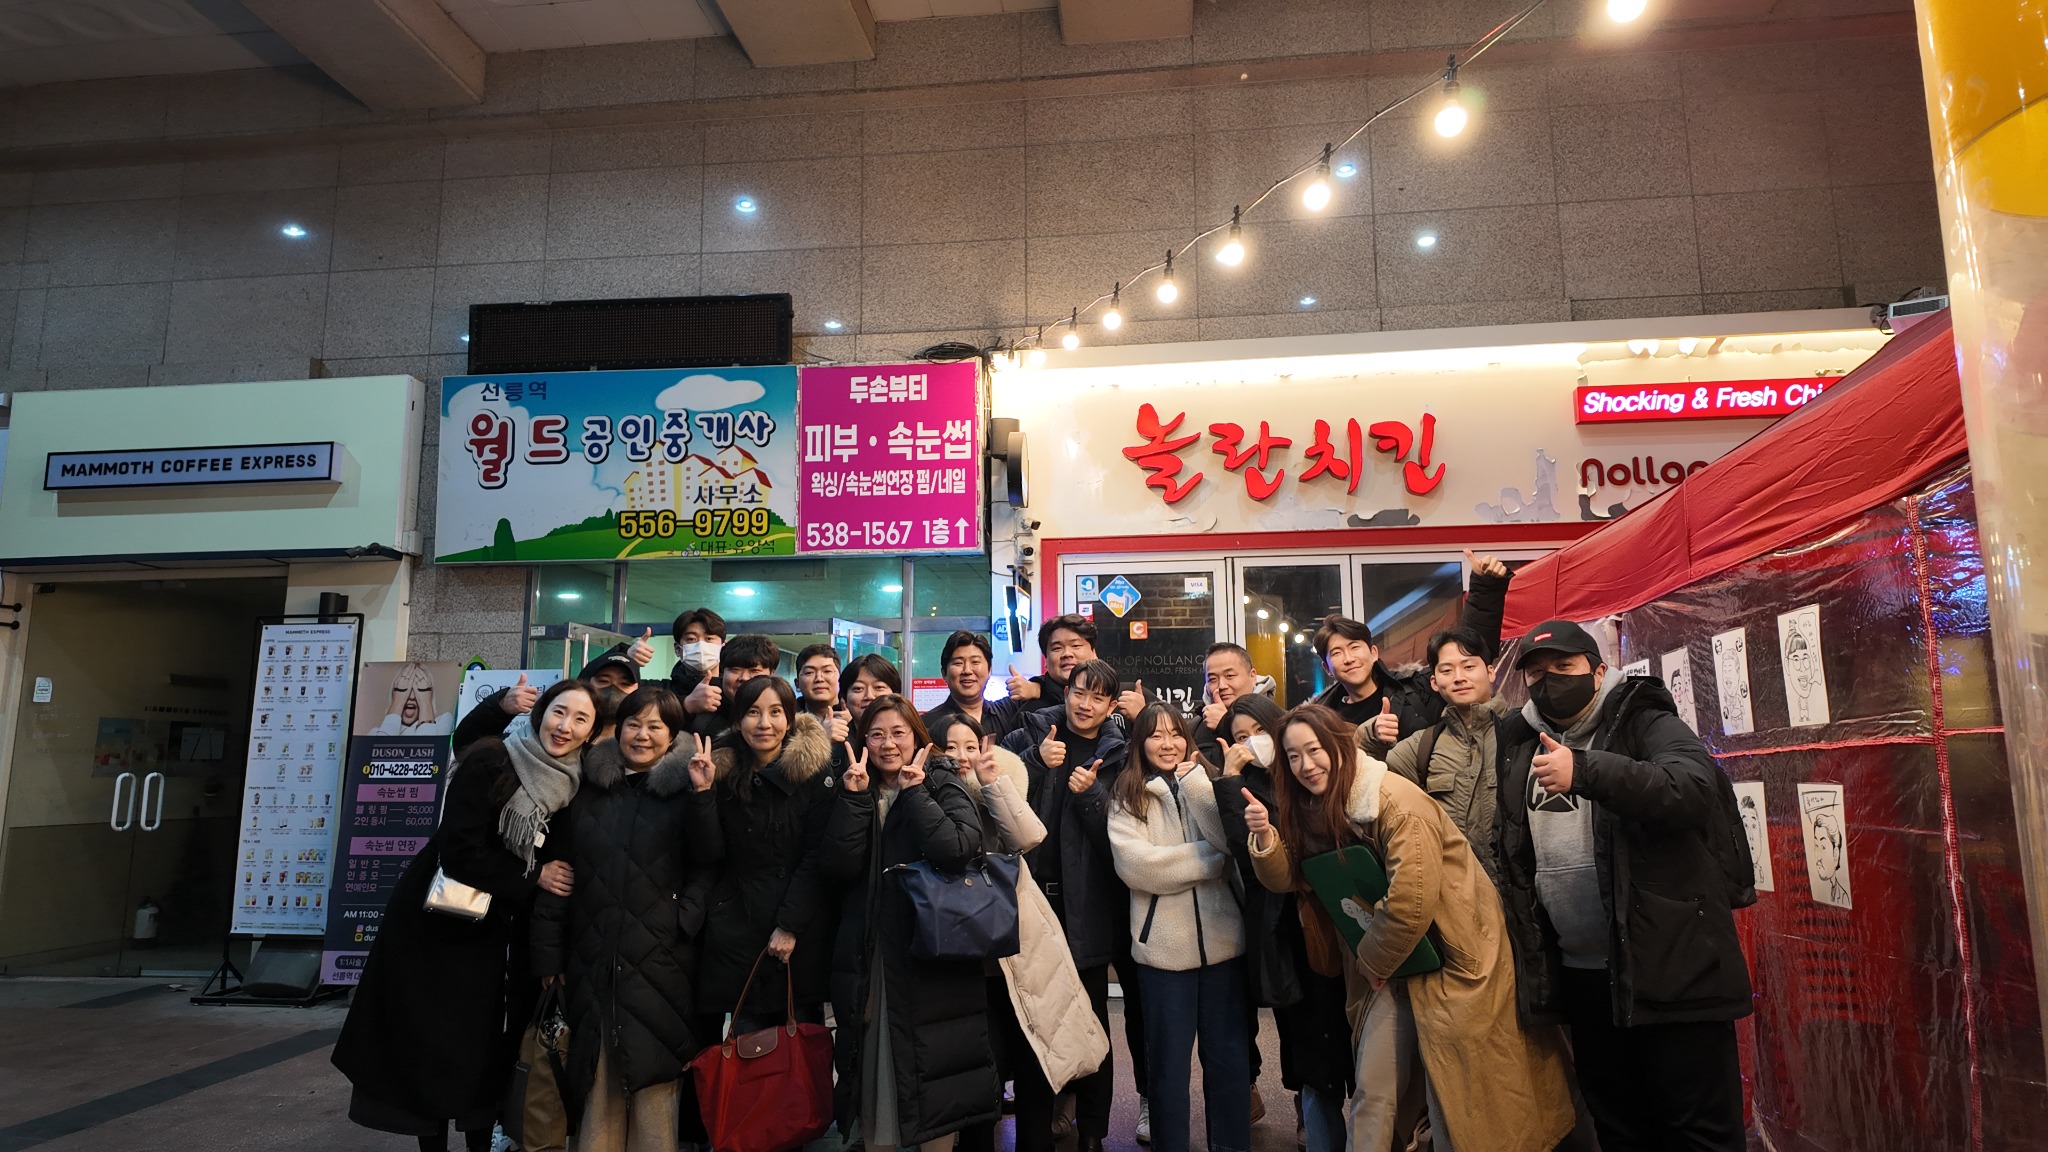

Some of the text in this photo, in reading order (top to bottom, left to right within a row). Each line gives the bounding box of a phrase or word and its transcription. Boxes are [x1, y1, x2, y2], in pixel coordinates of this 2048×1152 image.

[480, 381, 548, 402] 선릉역
[850, 374, 928, 403] 두손뷰티
[1583, 384, 1824, 413] Shocking & Fresh Chi
[465, 408, 776, 489] 월드 공인중개사
[804, 424, 859, 463] 피부
[887, 419, 972, 461] 속눈썹
[61, 454, 317, 477] MAMMOTH COFFEE EXPRESS
[693, 484, 763, 505] 사무소
[617, 508, 770, 538] 556-9799
[806, 518, 950, 547] 538-1567 1층
[1144, 654, 1193, 666] NOLLAN
[377, 786, 419, 798] 속눈썹 펌
[365, 839, 417, 852] 속눈썹 연장
[343, 911, 357, 919] AM
[358, 911, 379, 919] 11:00
[365, 924, 379, 932] dus
